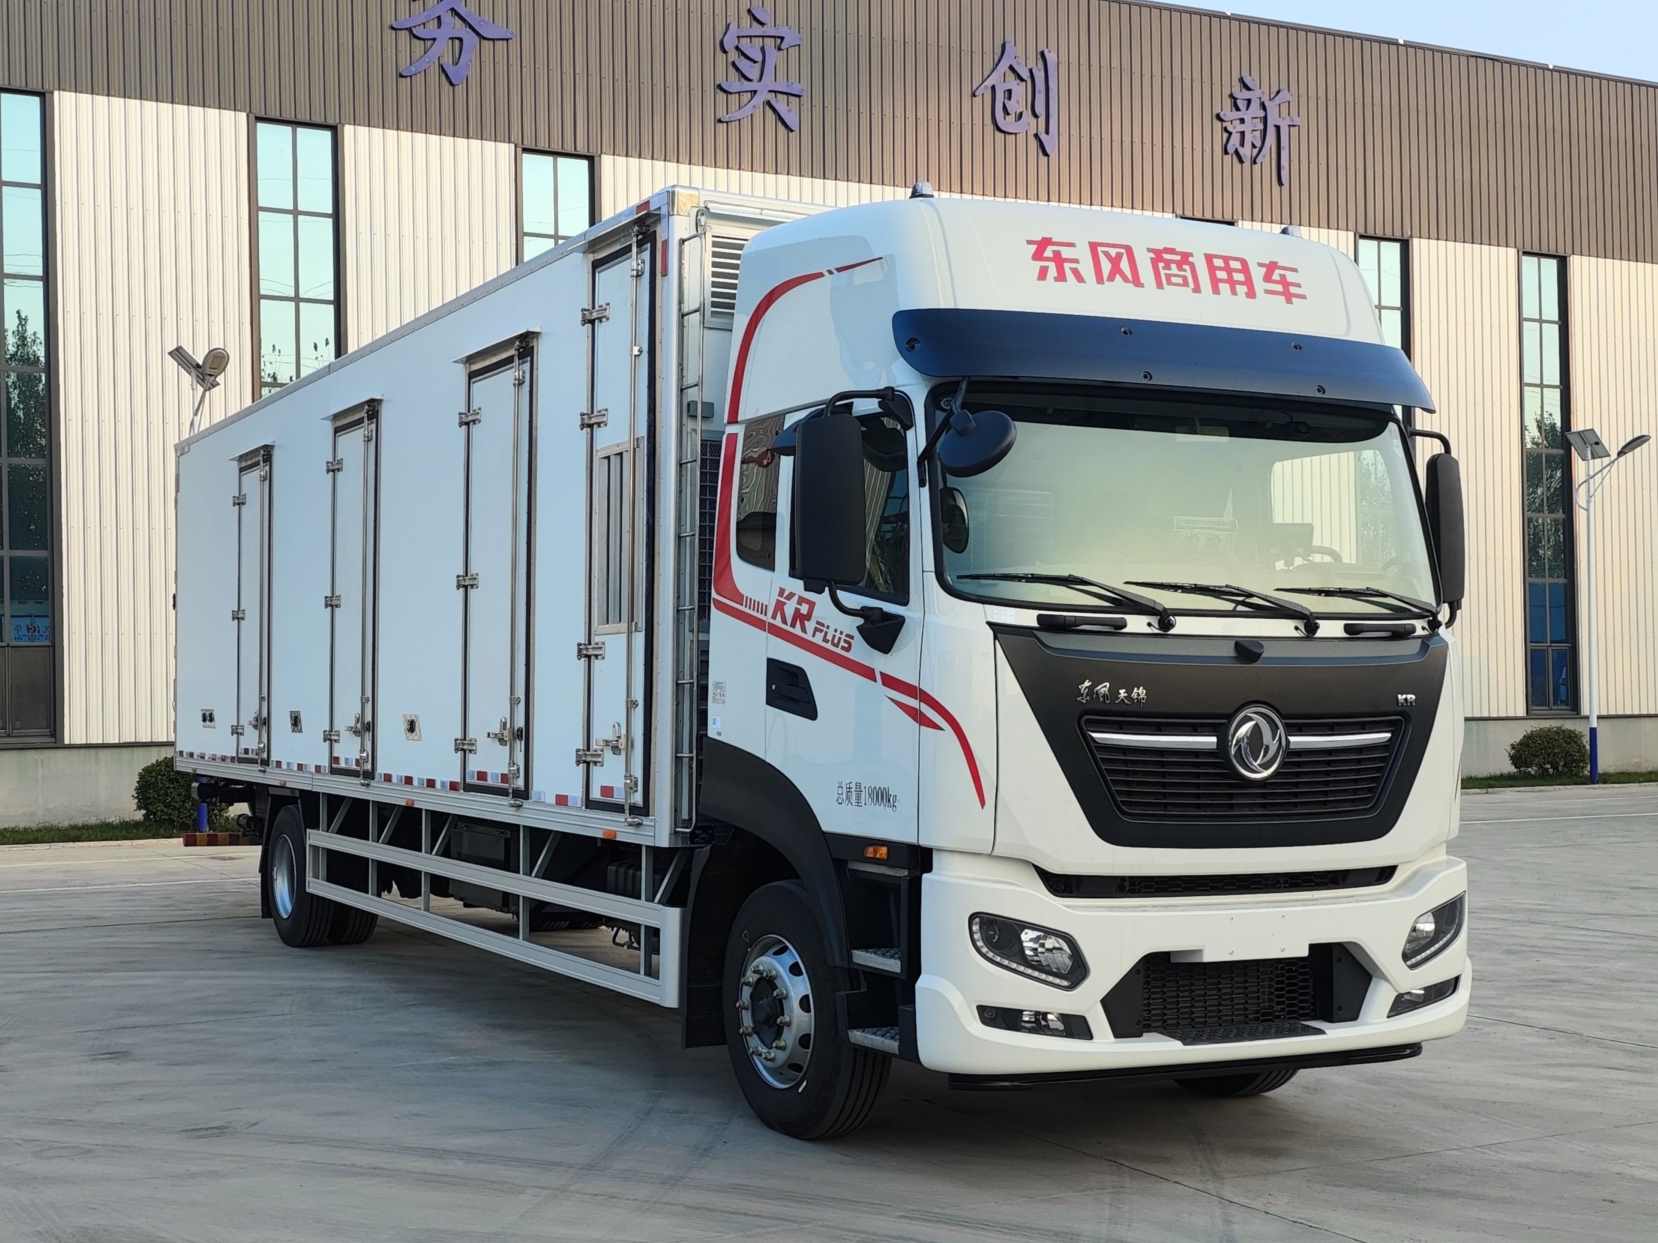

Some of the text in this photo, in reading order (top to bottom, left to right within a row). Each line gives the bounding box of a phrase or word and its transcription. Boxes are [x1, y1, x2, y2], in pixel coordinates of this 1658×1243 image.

[1026, 236, 1308, 304] 东风商用车
[771, 586, 855, 653] KR PLUS
[1076, 679, 1148, 705] 东风天锦
[1397, 693, 1417, 706] KR
[835, 780, 898, 813] 总质量18000kg
